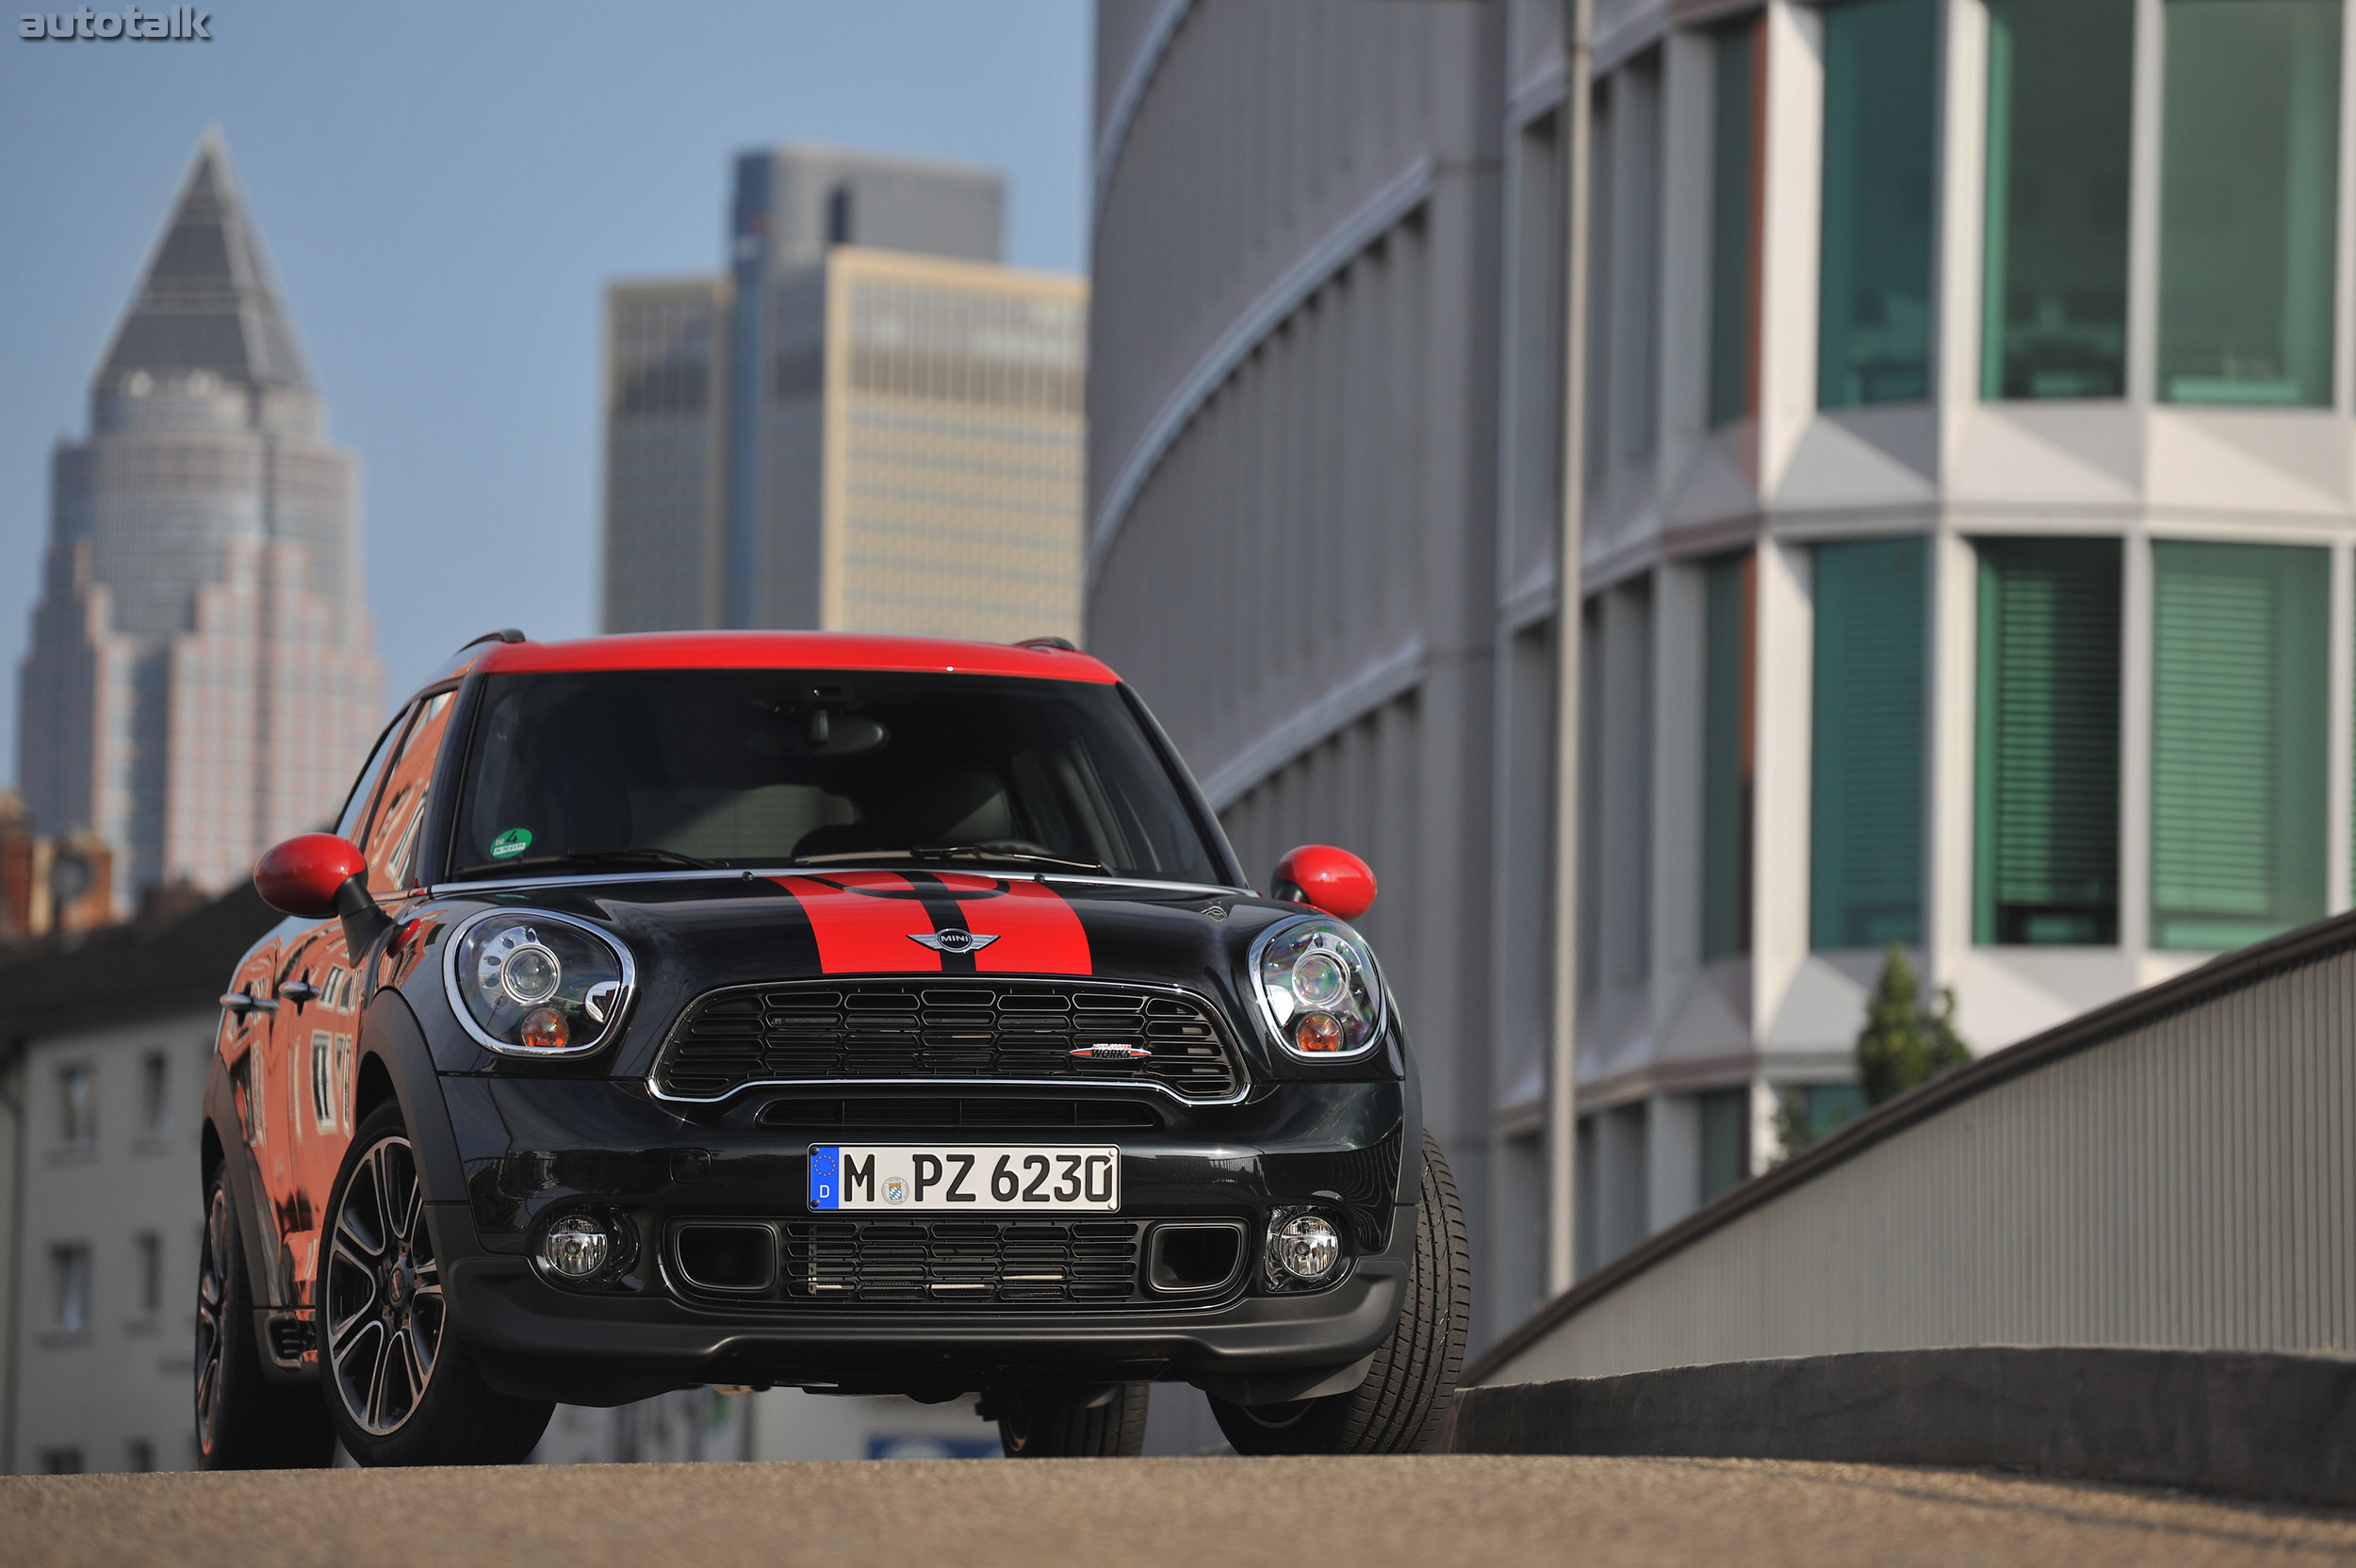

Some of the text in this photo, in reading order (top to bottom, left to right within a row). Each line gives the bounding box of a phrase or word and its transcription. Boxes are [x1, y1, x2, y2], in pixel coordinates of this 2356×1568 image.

[506, 830, 517, 842] 4
[1091, 1049, 1131, 1058] WORKS
[844, 1154, 875, 1202] M
[912, 1154, 976, 1202] PZ
[991, 1154, 1113, 1202] 6230
[819, 1184, 830, 1198] D
